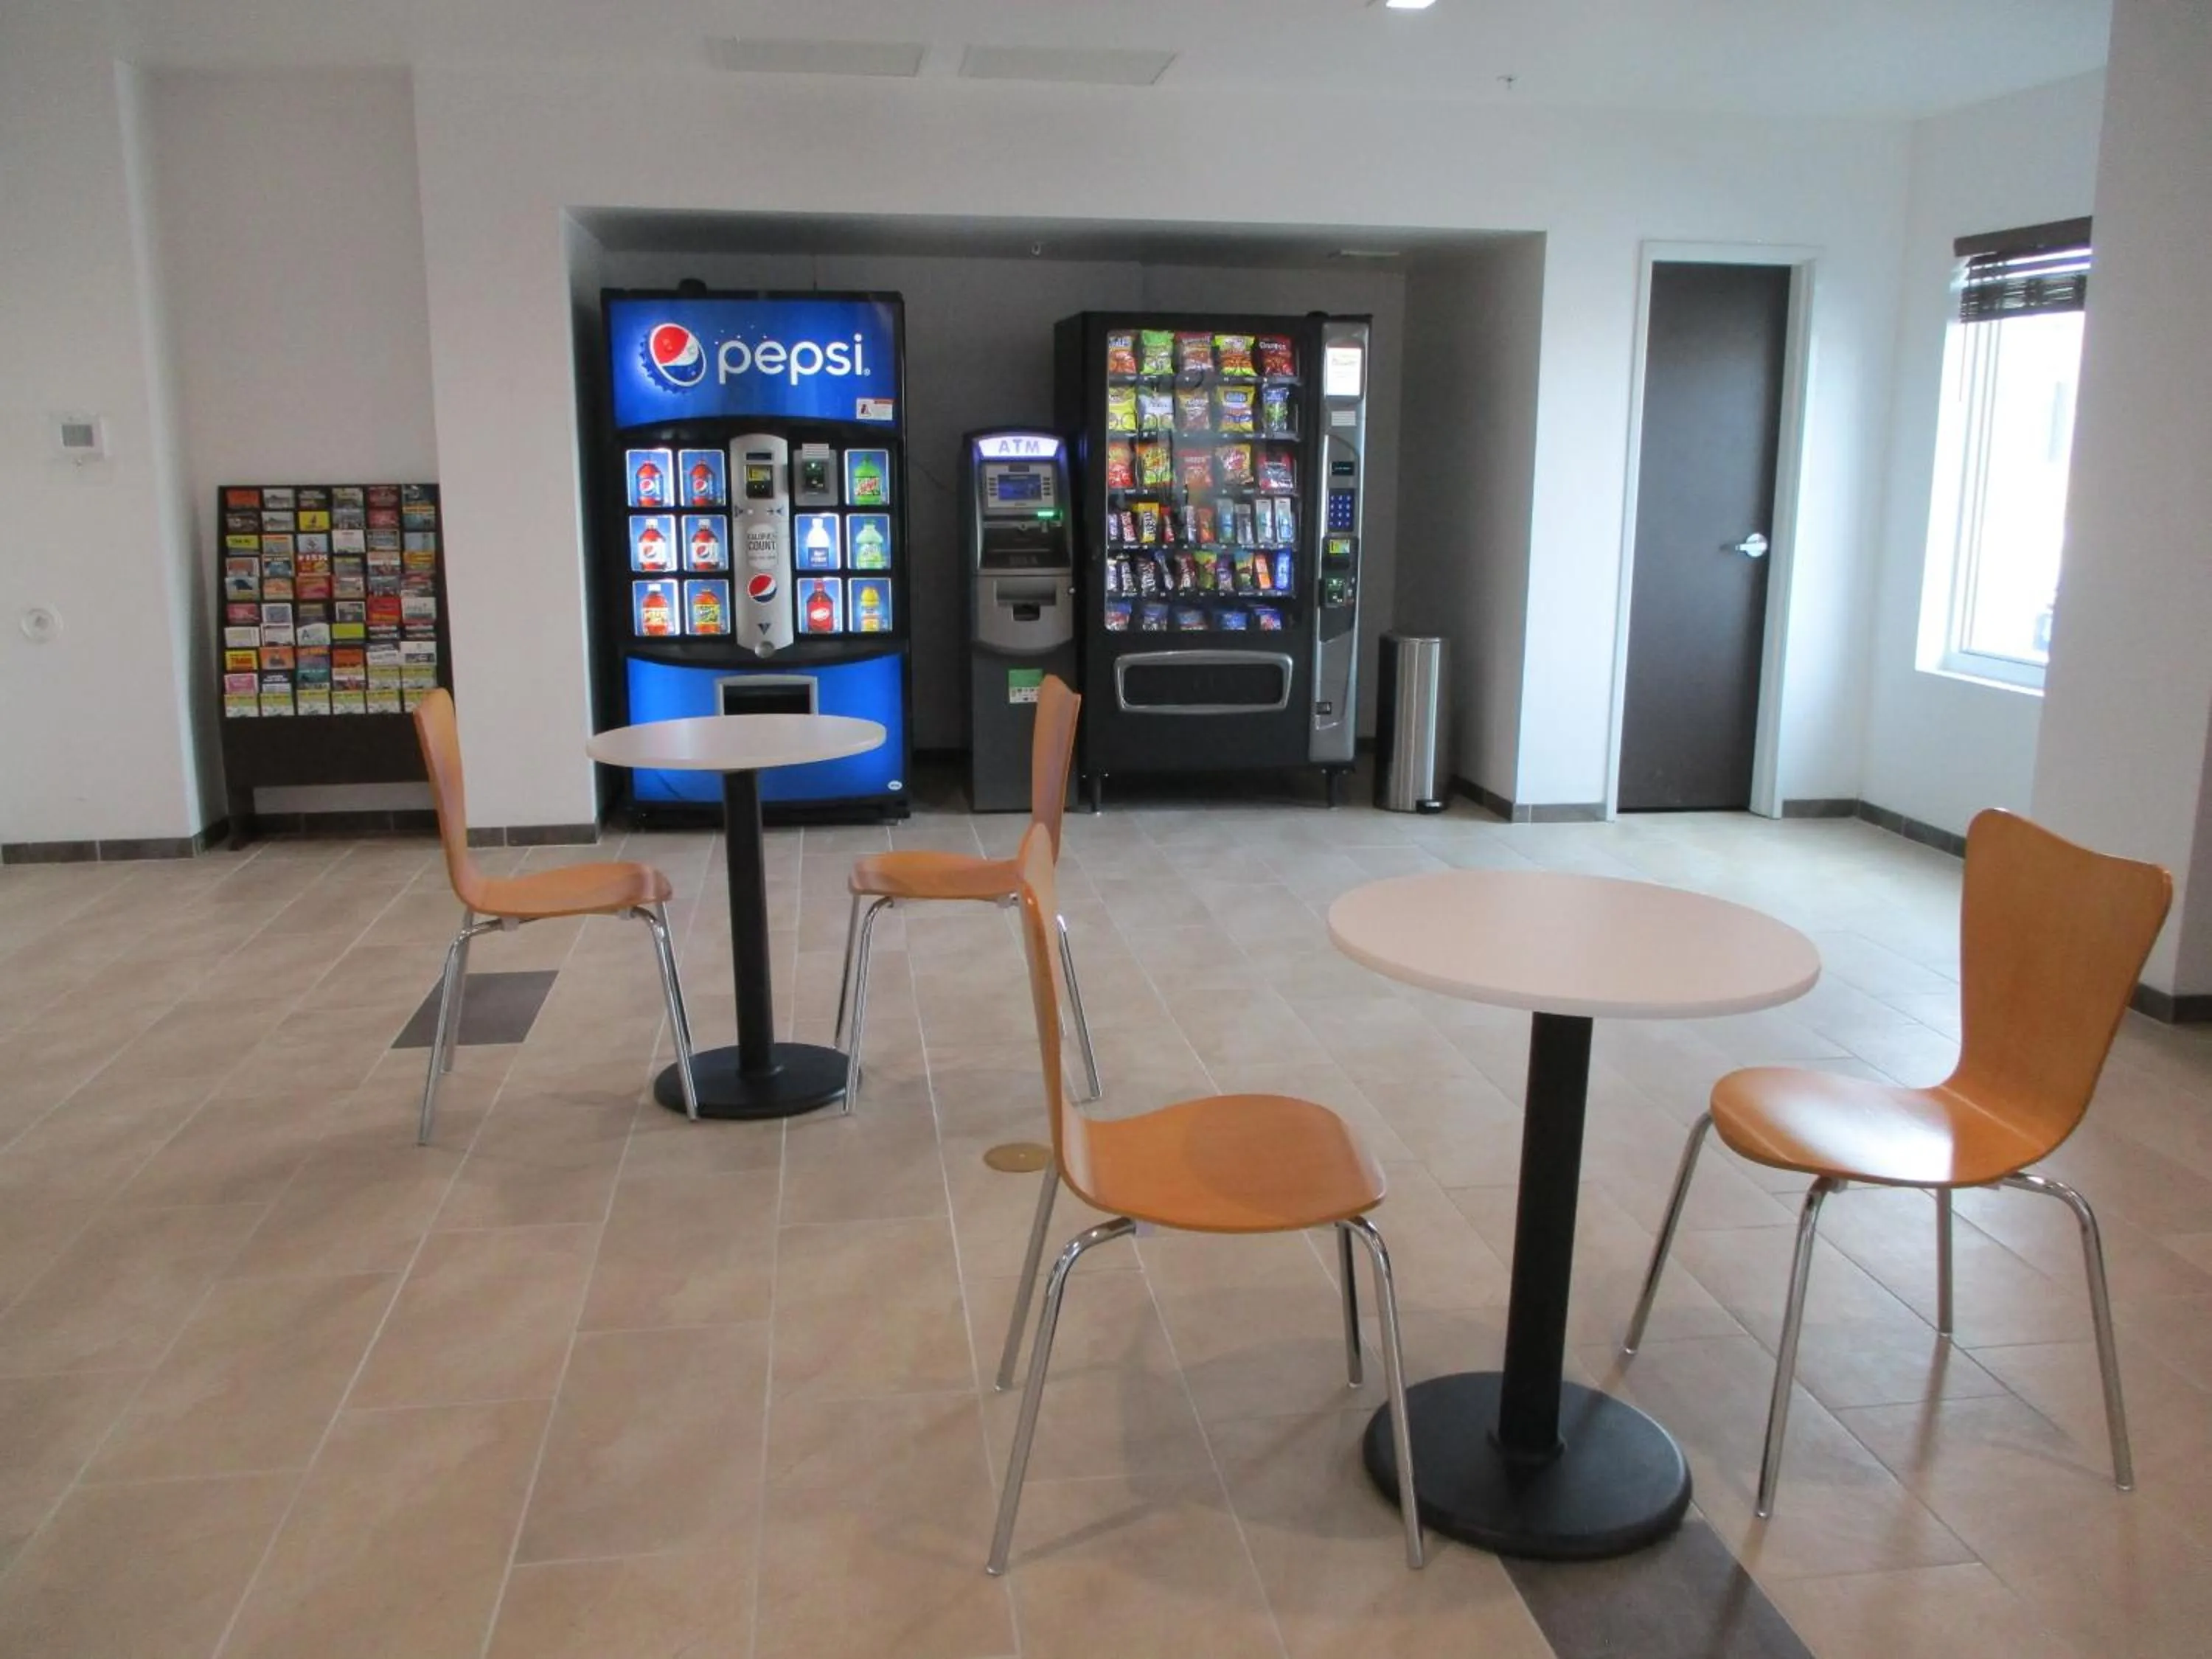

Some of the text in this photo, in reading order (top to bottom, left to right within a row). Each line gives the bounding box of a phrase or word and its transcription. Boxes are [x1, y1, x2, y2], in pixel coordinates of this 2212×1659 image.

[717, 333, 863, 386] pepsi
[998, 438, 1041, 454] ATM
[748, 540, 776, 551] COUNT
